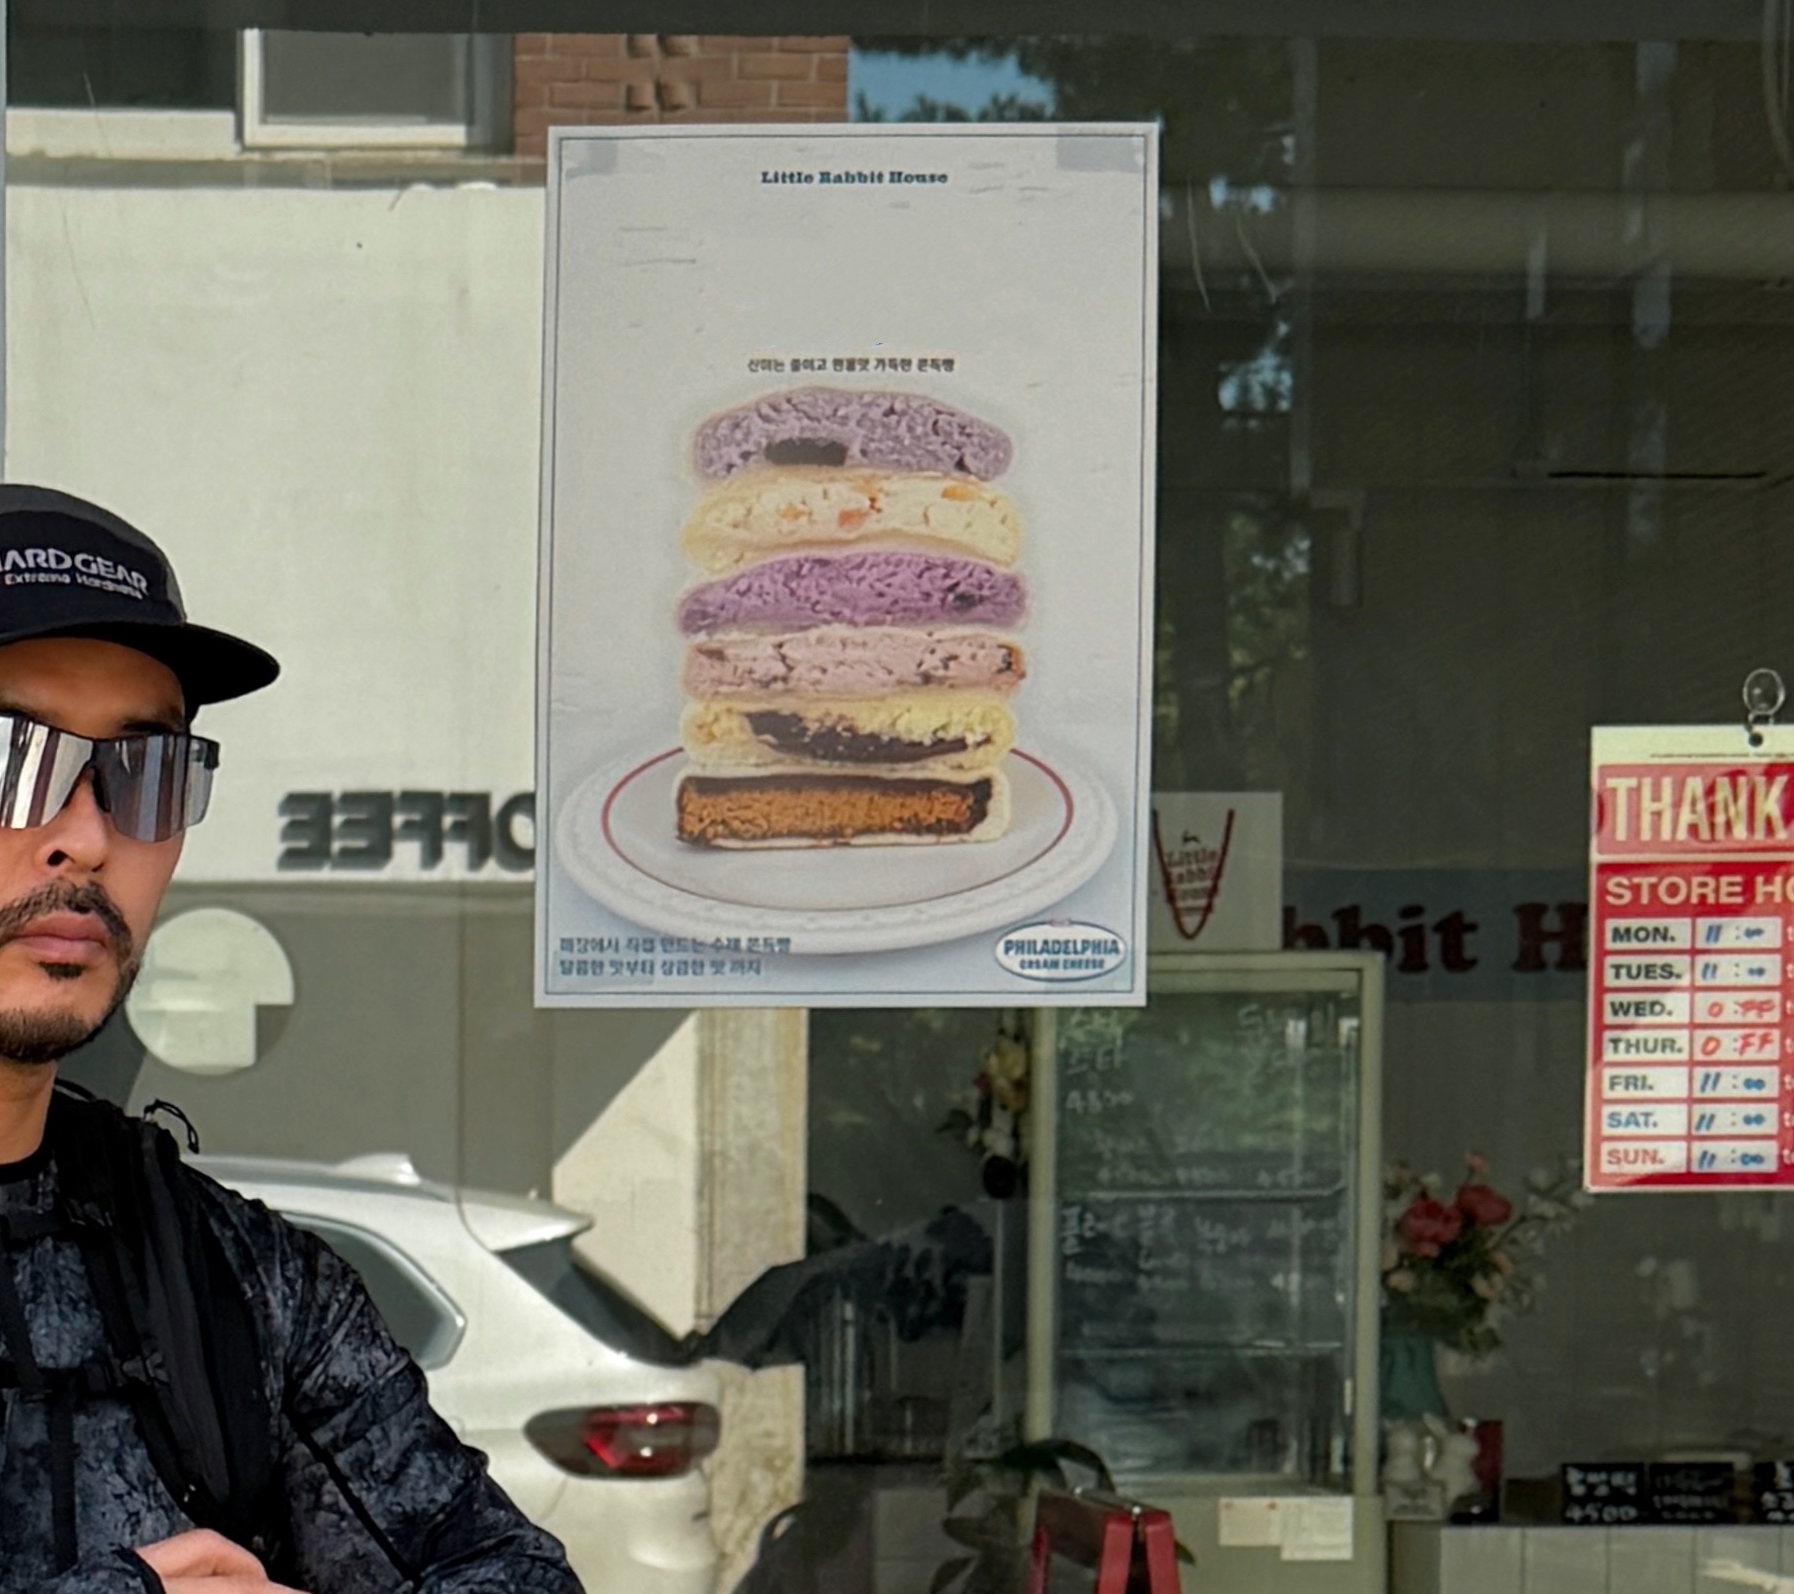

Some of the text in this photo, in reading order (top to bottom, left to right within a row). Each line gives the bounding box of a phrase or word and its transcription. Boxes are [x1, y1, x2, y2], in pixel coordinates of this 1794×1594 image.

[761, 171, 948, 184] Little Rabbit House
[1606, 775, 1788, 842] THANK
[1606, 875, 1794, 906] STORE H
[1611, 926, 1676, 944] MON.
[1003, 939, 1120, 956] PHILADELPHIA
[1610, 963, 1683, 981] TUES.
[1610, 1000, 1673, 1018] WED.
[1609, 1037, 1684, 1055] THUR.
[1608, 1074, 1654, 1091] FRI.
[1607, 1112, 1658, 1128] SAT.
[1606, 1149, 1664, 1166] SUN.
